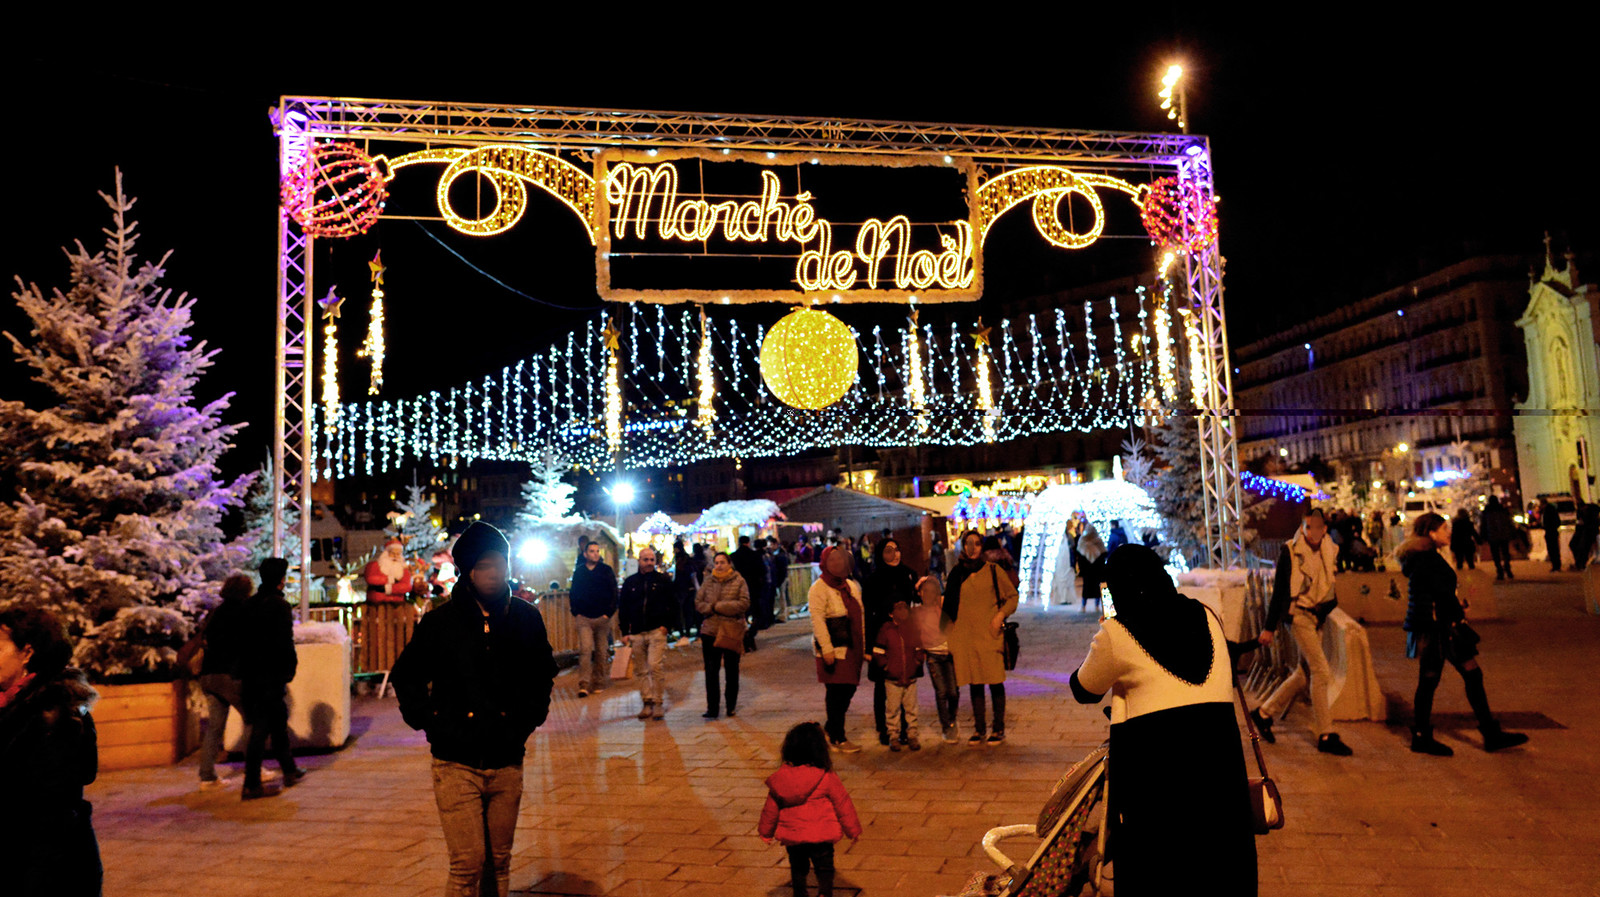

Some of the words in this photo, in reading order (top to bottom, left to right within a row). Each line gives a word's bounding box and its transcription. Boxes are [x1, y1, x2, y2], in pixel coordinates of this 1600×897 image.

[605, 162, 819, 243] Marché
[796, 219, 857, 291] de
[856, 215, 975, 290] Noël
